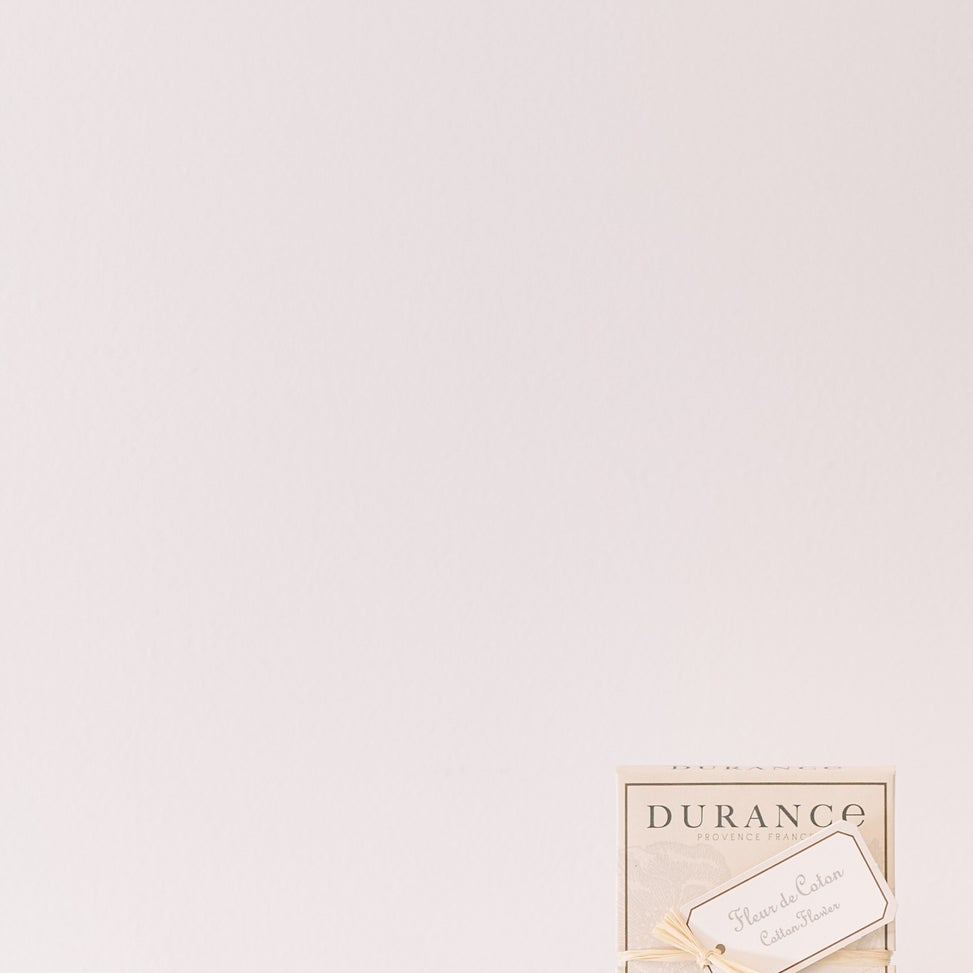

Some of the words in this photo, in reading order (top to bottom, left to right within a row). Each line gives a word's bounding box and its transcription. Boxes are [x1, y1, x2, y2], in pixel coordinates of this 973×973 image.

[697, 832, 761, 841] PROVENCE
[728, 903, 778, 933] Fleur
[780, 892, 799, 909] de
[795, 868, 845, 897] Coton
[760, 923, 800, 947] Cotton
[796, 902, 841, 928] Flower
